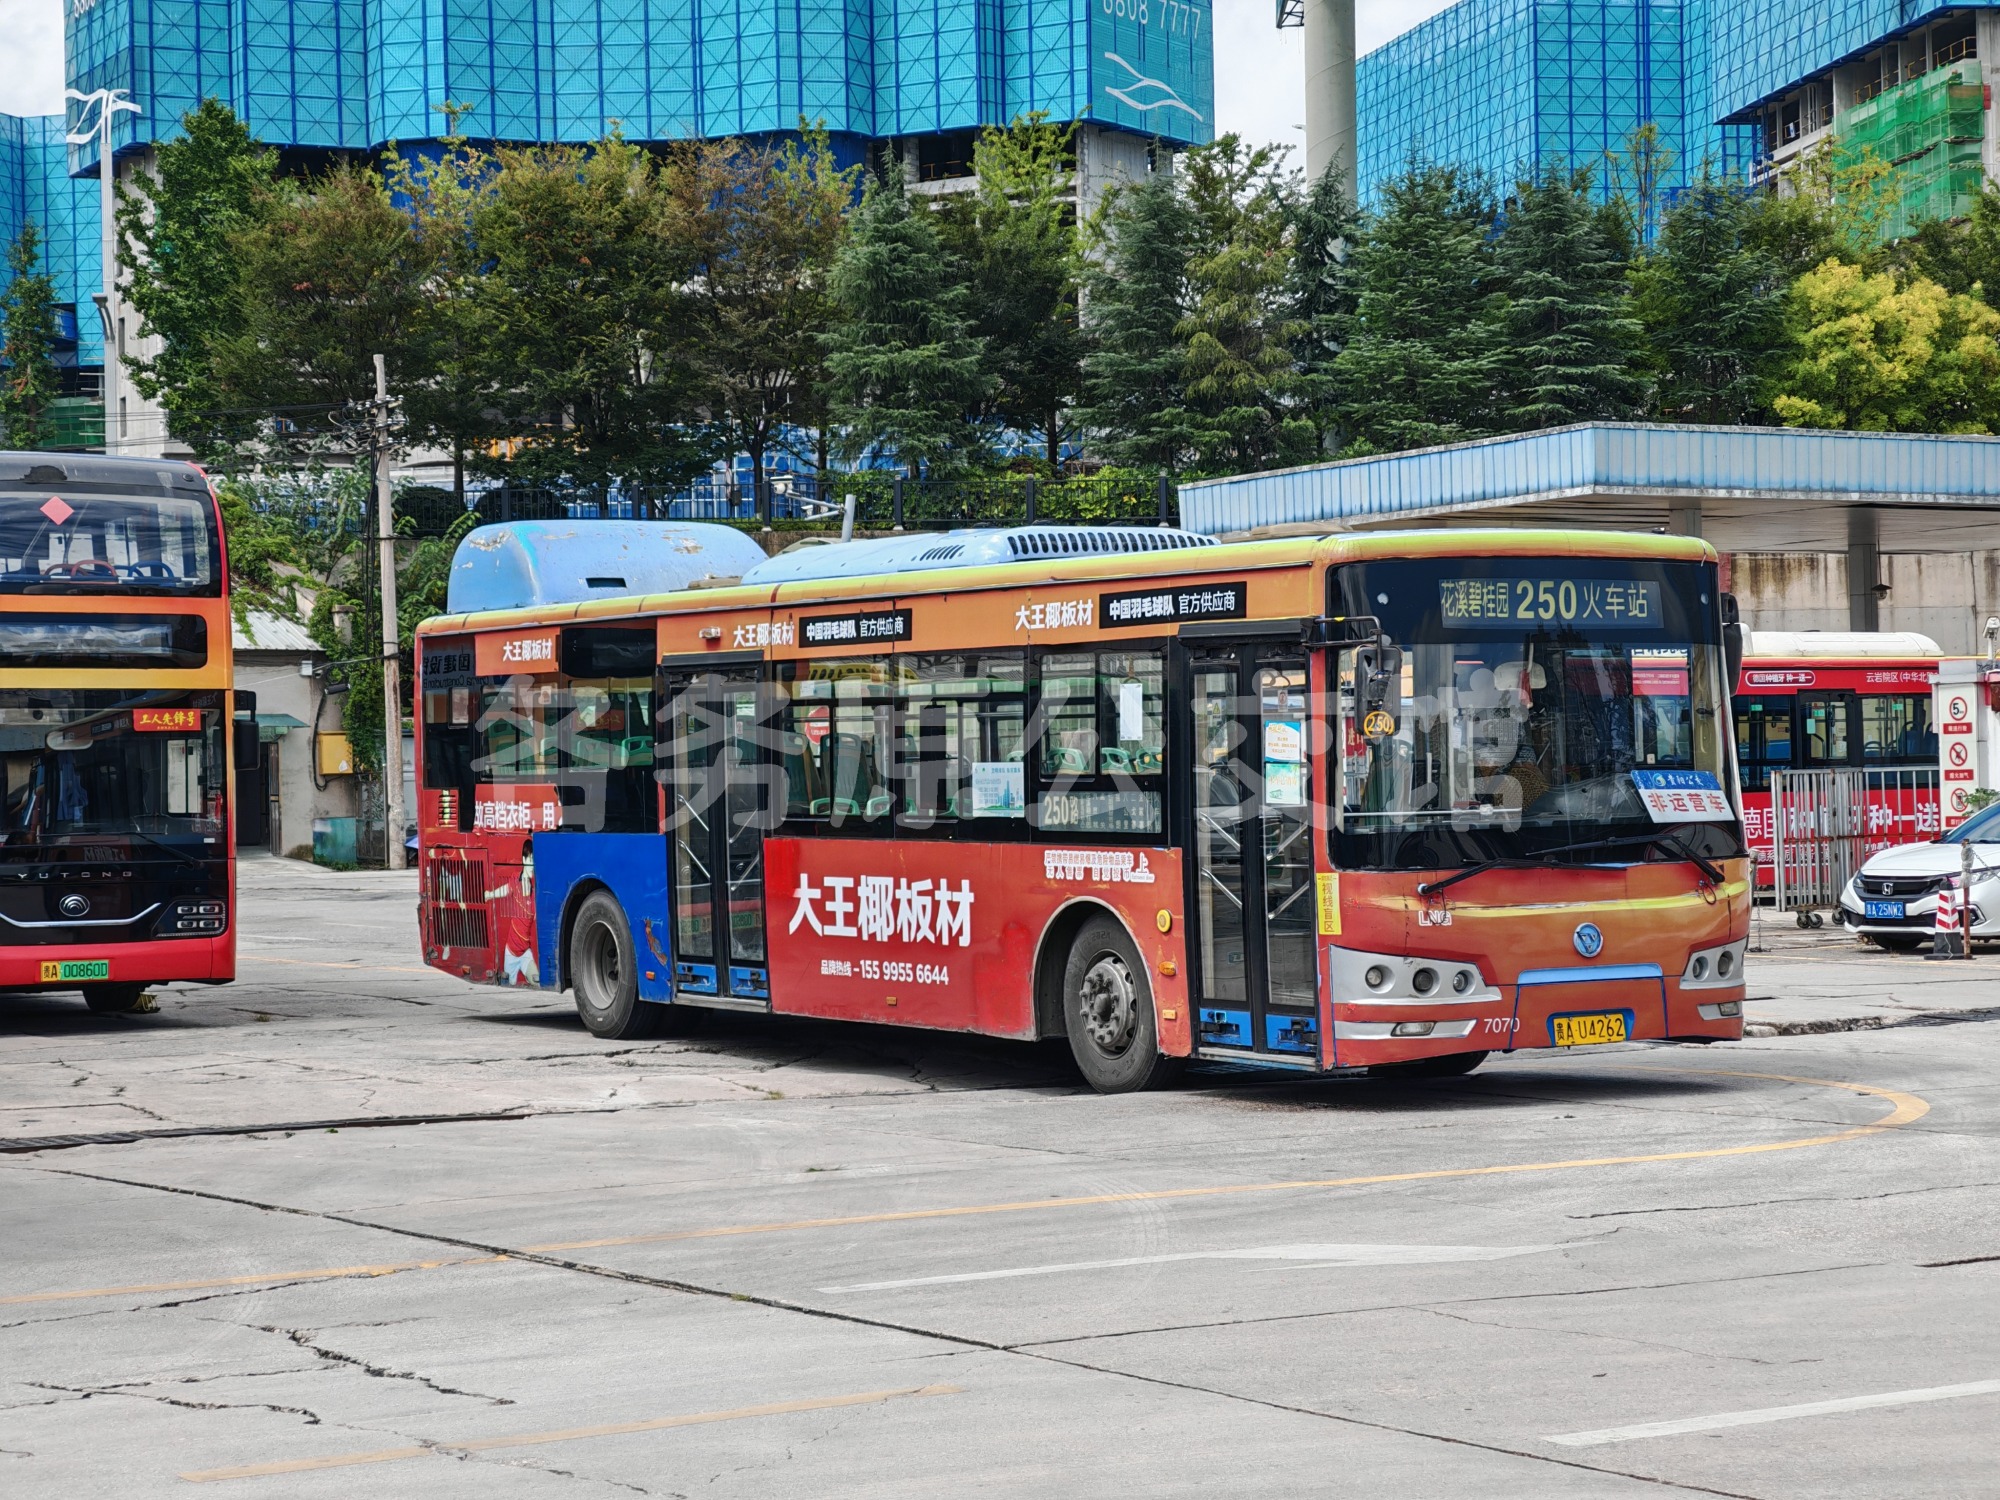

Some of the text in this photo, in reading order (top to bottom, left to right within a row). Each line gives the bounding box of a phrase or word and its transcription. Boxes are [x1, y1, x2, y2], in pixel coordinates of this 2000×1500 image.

[1159, 0, 1201, 40] 7777
[1015, 590, 1236, 631] 大王椰板材 中国羽毛球队 官方供应商
[1441, 579, 1649, 620] 花溪碧桂园 250 火车站
[733, 615, 904, 649] 大王椰板材 中国羽毛球队 官方供应商
[502, 637, 553, 662] 大王椰板材
[140, 710, 196, 727] 工人先锋号
[1367, 714, 1392, 733] 250
[1044, 795, 1079, 826] 250路
[1648, 792, 1726, 814] 非运营车
[17, 871, 132, 879] YUTONG
[789, 873, 975, 947] 大王椰板材
[1418, 910, 1452, 927] LNG
[883, 960, 914, 984] 9955
[915, 963, 949, 986] 6644
[1483, 1017, 1521, 1034] 7070
